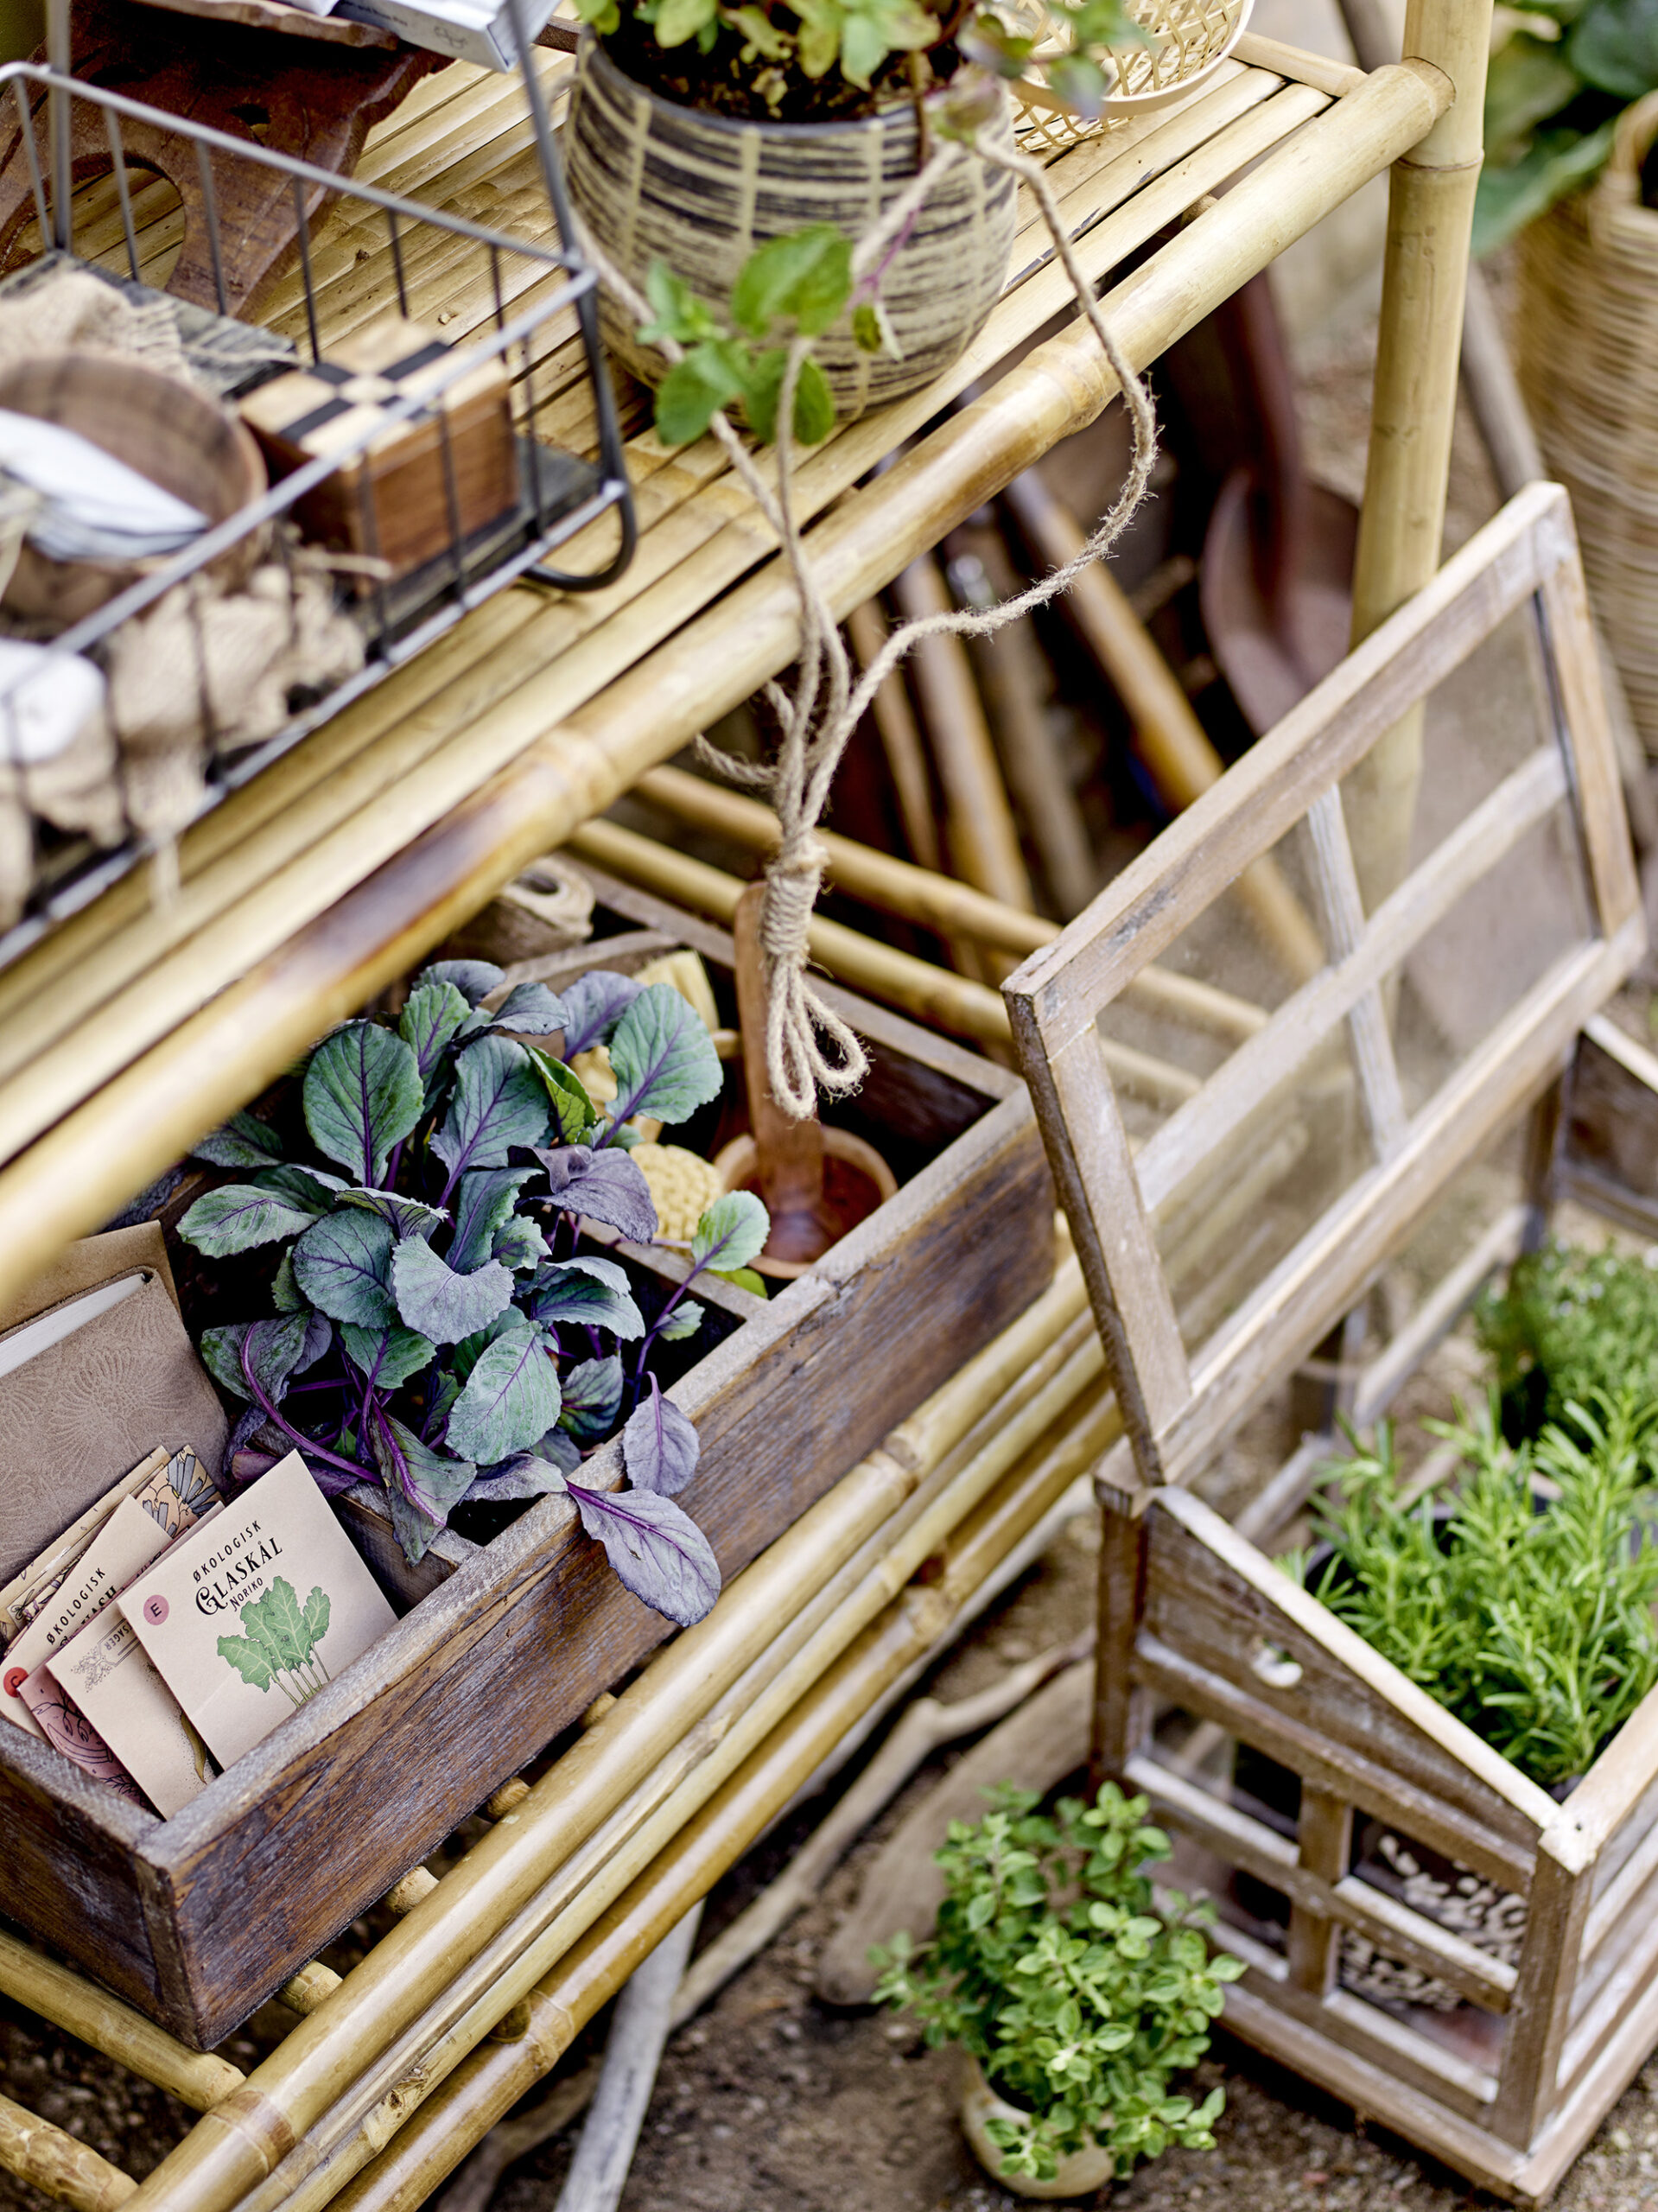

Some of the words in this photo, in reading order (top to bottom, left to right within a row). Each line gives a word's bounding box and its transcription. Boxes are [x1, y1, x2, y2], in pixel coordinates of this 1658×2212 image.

[193, 1520, 262, 1584] ØKOLOGISK
[195, 1537, 283, 1616] GLASKÅL
[46, 1567, 105, 1646] ØKOLOGISK
[149, 1603, 162, 1618] E
[229, 1577, 264, 1612] NORIKO
